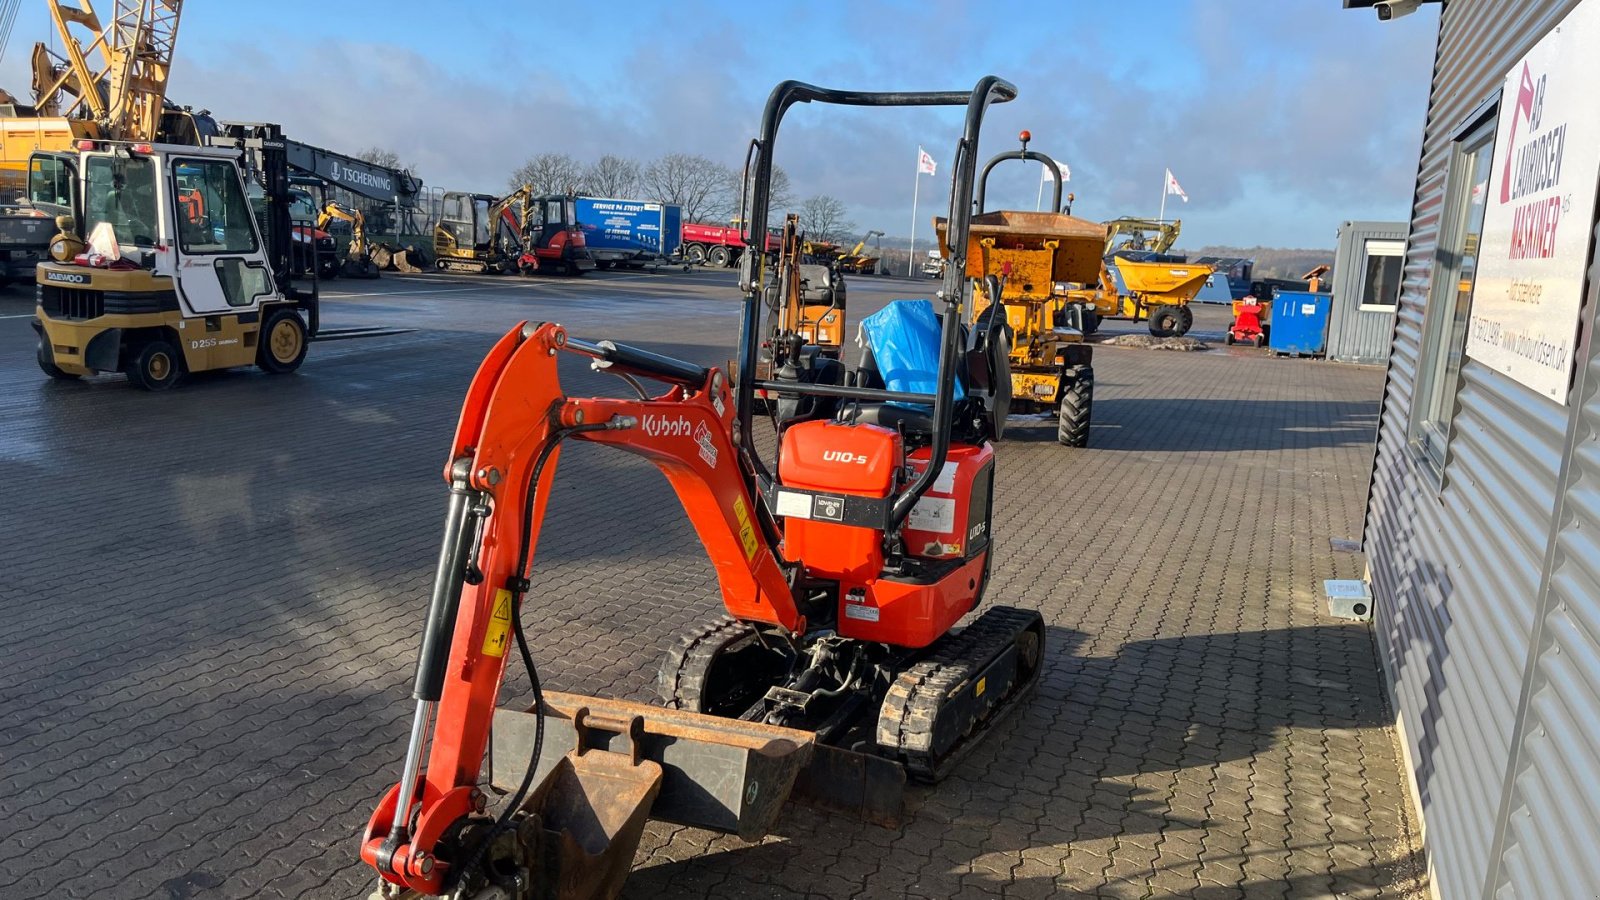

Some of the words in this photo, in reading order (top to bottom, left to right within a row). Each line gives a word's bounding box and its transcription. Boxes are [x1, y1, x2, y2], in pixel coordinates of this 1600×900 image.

[1529, 74, 1547, 134] AB
[1512, 123, 1567, 200] LAURIDSEN
[342, 167, 391, 191] TSCHERNING
[1509, 196, 1561, 260] MASKINER
[47, 272, 84, 283] DAEWOO
[191, 341, 199, 349] D
[200, 338, 217, 348] 25S
[642, 414, 692, 436] Kubota
